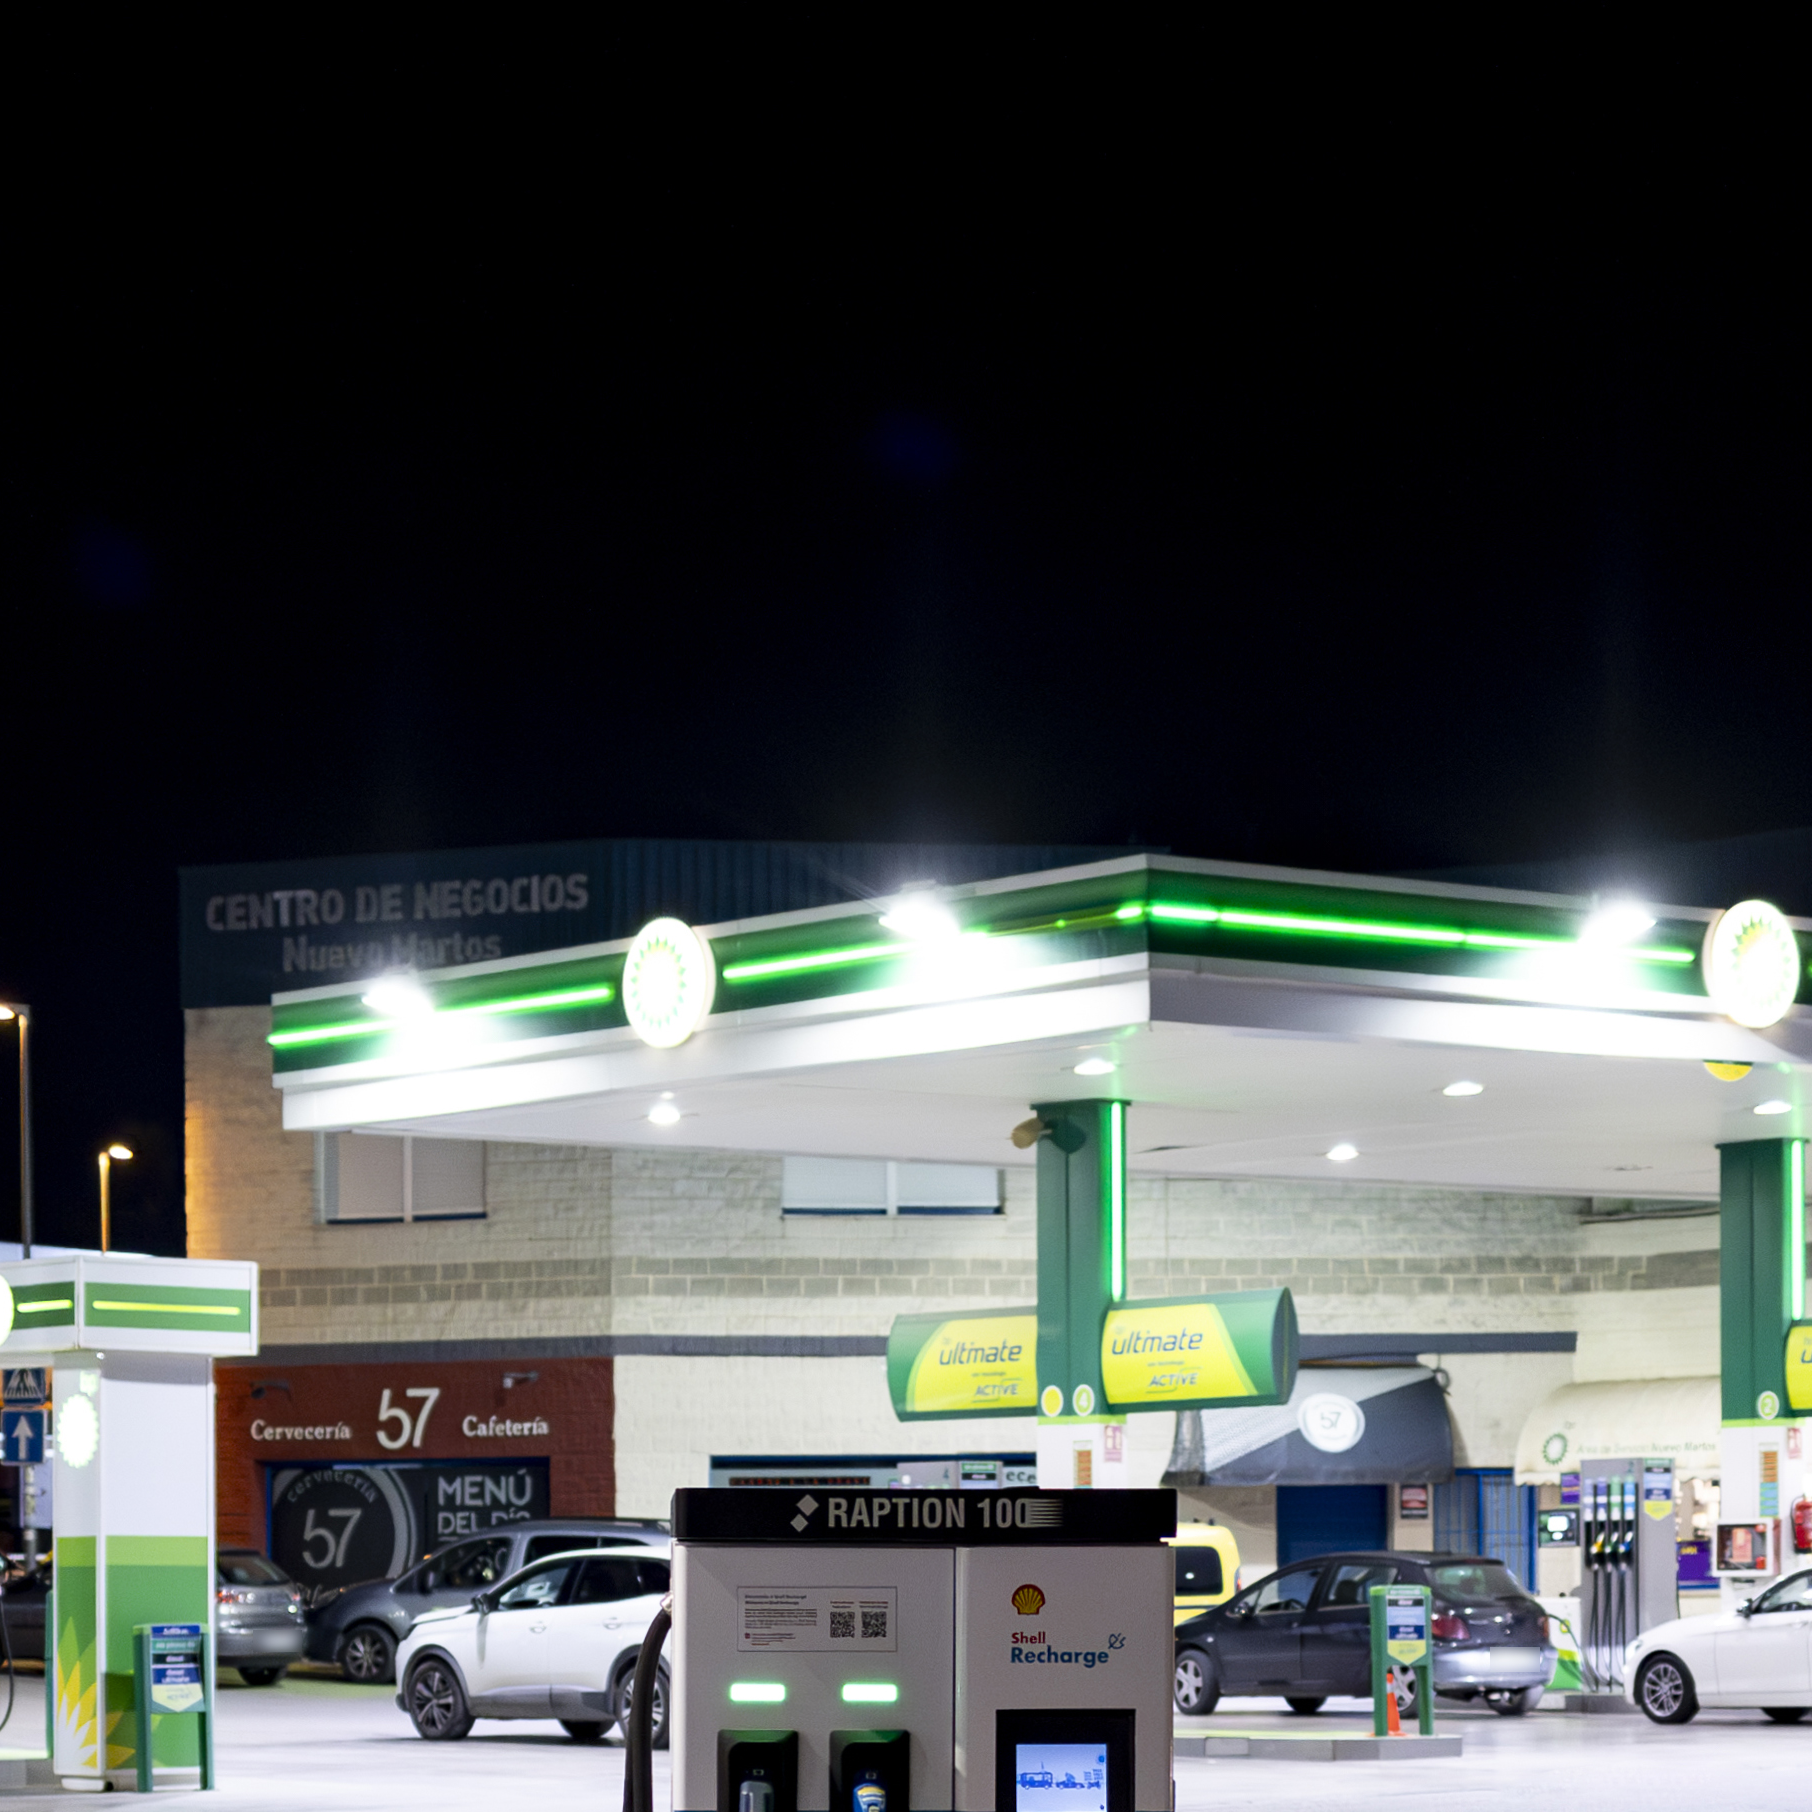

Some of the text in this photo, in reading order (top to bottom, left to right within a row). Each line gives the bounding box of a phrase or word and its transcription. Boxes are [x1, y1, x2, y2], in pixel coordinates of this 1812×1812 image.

[206, 874, 588, 931] CENTRO DE NEGOCIOS
[391, 929, 502, 970] Martos
[939, 1339, 1023, 1366] ultimate
[1111, 1328, 1204, 1356] ultimate
[974, 1382, 1019, 1397] ACTIVE
[1148, 1372, 1200, 1388] ACTIVE
[250, 1418, 353, 1442] Cervecería
[376, 1387, 441, 1450] 57
[462, 1415, 549, 1438] Cafetería
[1320, 1411, 1342, 1430] 57
[437, 1468, 533, 1508] MENÚ
[437, 1511, 479, 1535] DEL
[828, 1497, 1037, 1529] RAPTION 100
[301, 1508, 362, 1569] 57
[1011, 1631, 1046, 1644] Shell
[1010, 1645, 1109, 1669] Recharge
